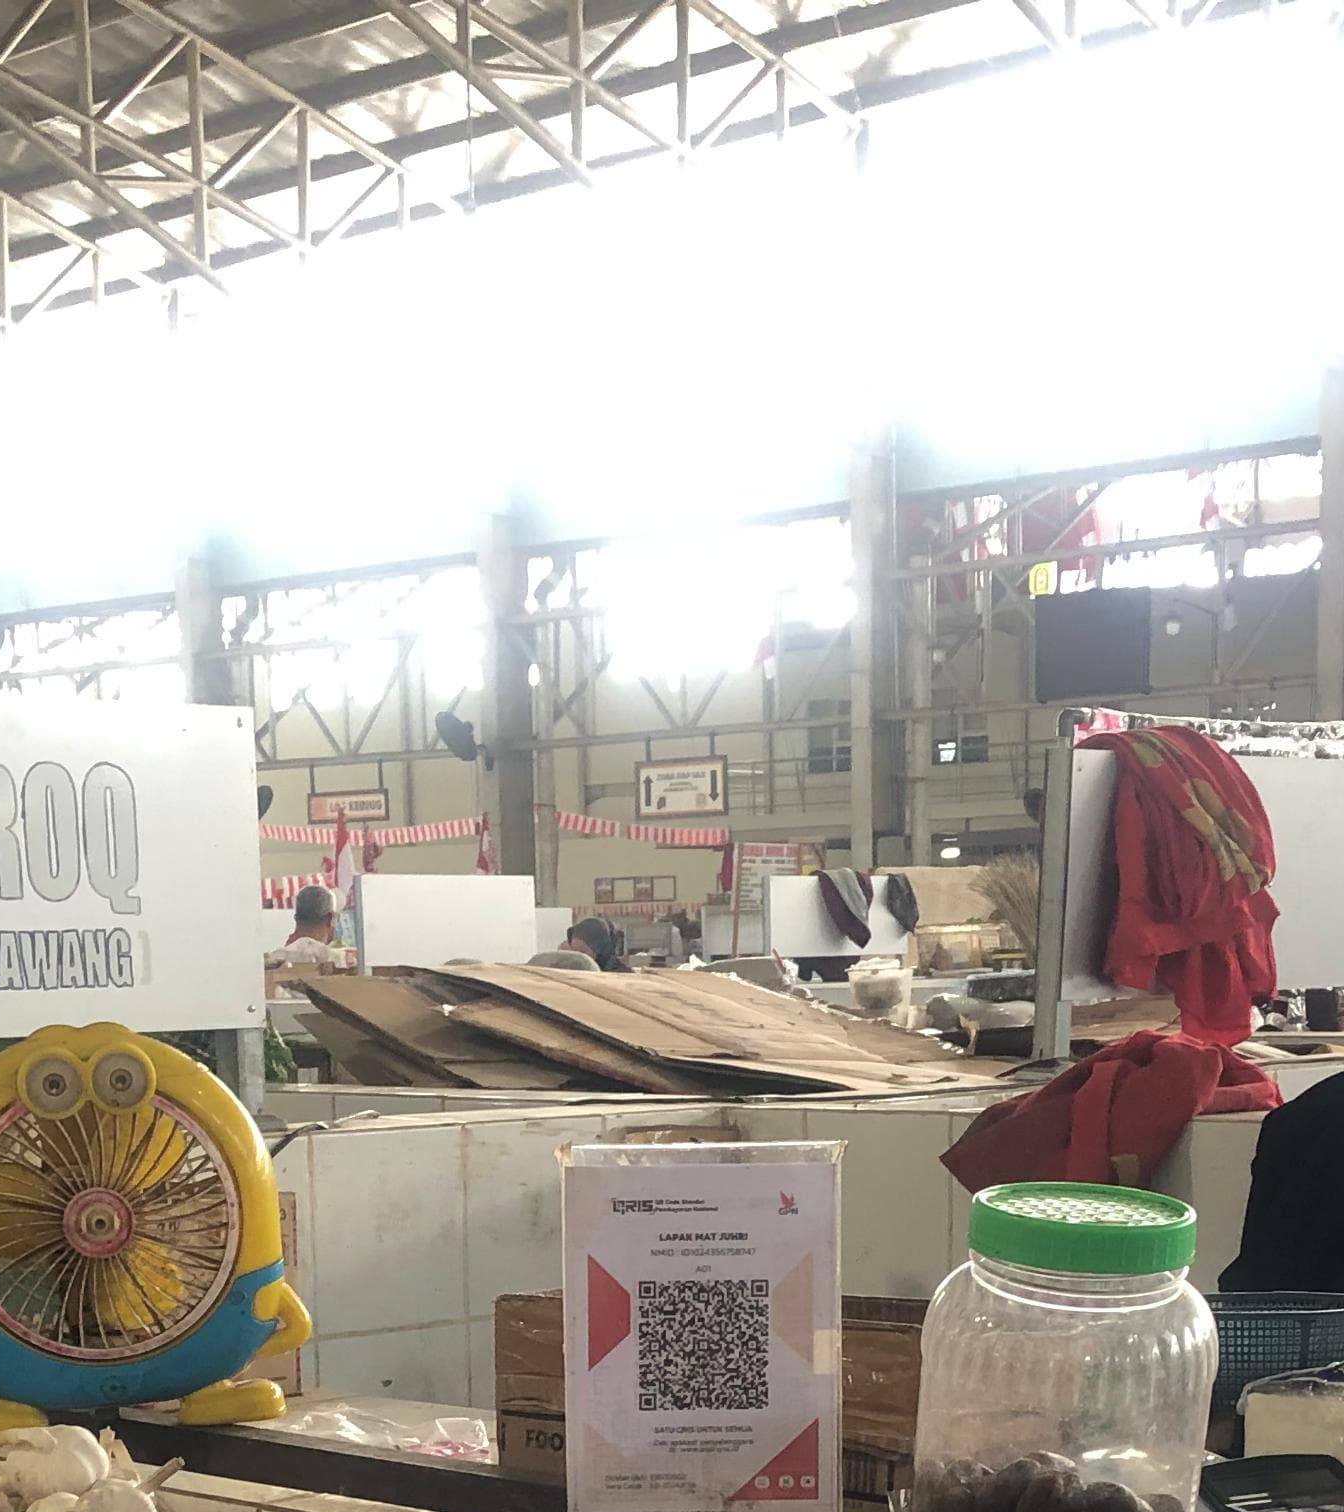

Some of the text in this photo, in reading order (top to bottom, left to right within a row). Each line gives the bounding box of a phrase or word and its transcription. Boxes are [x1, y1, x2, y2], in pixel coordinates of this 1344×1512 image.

[612, 1199, 654, 1215] QRIS
[659, 1232, 748, 1241] LAPAK MAT JUHRI
